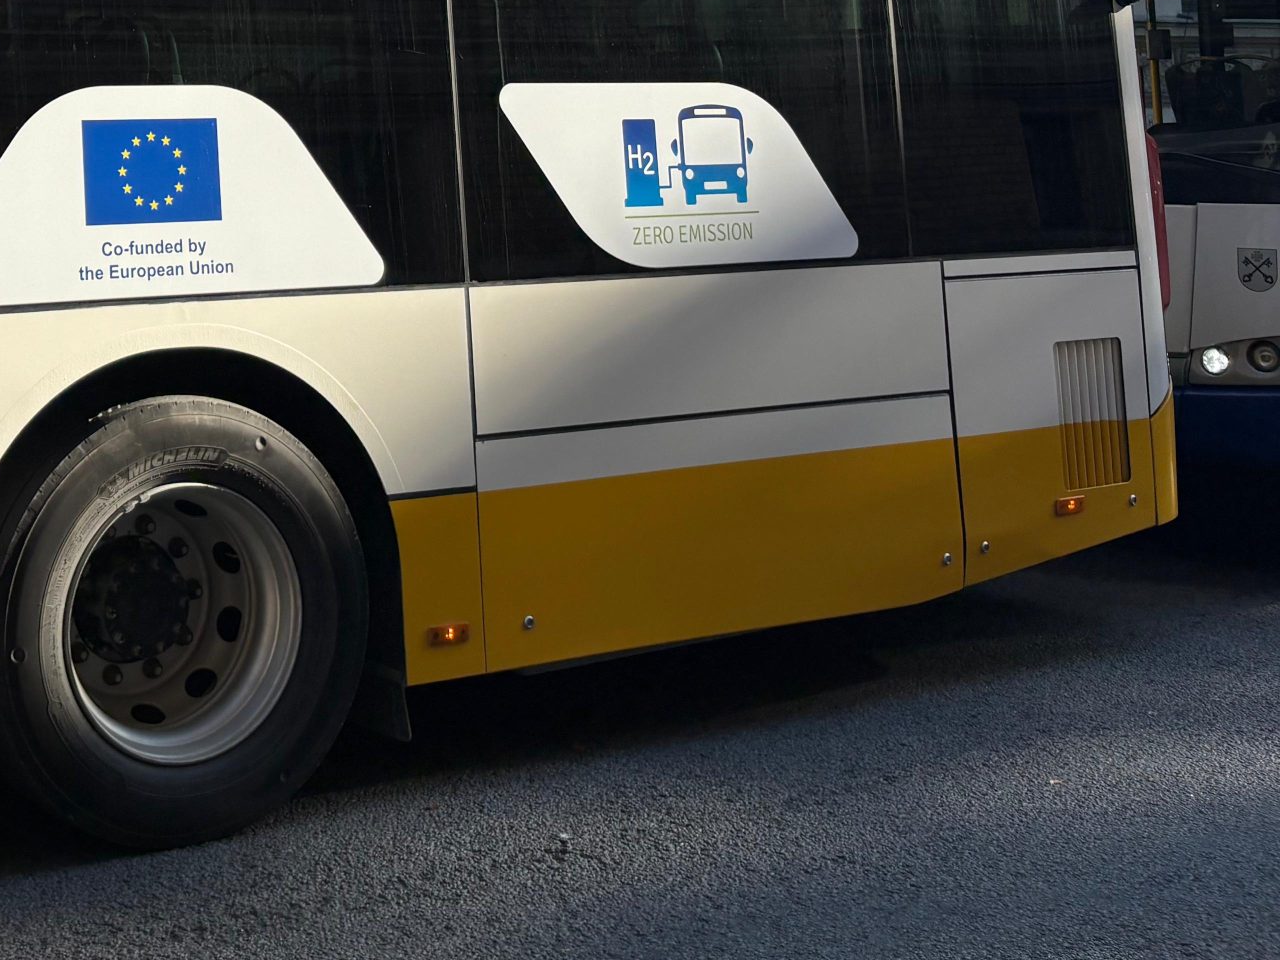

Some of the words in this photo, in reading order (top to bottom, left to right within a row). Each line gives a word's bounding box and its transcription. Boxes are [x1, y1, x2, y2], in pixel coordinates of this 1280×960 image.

[627, 144, 656, 176] H2
[632, 225, 674, 246] ZERO
[679, 222, 754, 244] EMISSION
[101, 239, 183, 257] Co-funded
[188, 238, 207, 256] by
[78, 266, 104, 281] the
[109, 264, 185, 281] European
[189, 260, 234, 275] Union
[128, 446, 220, 480] MICHELIN
